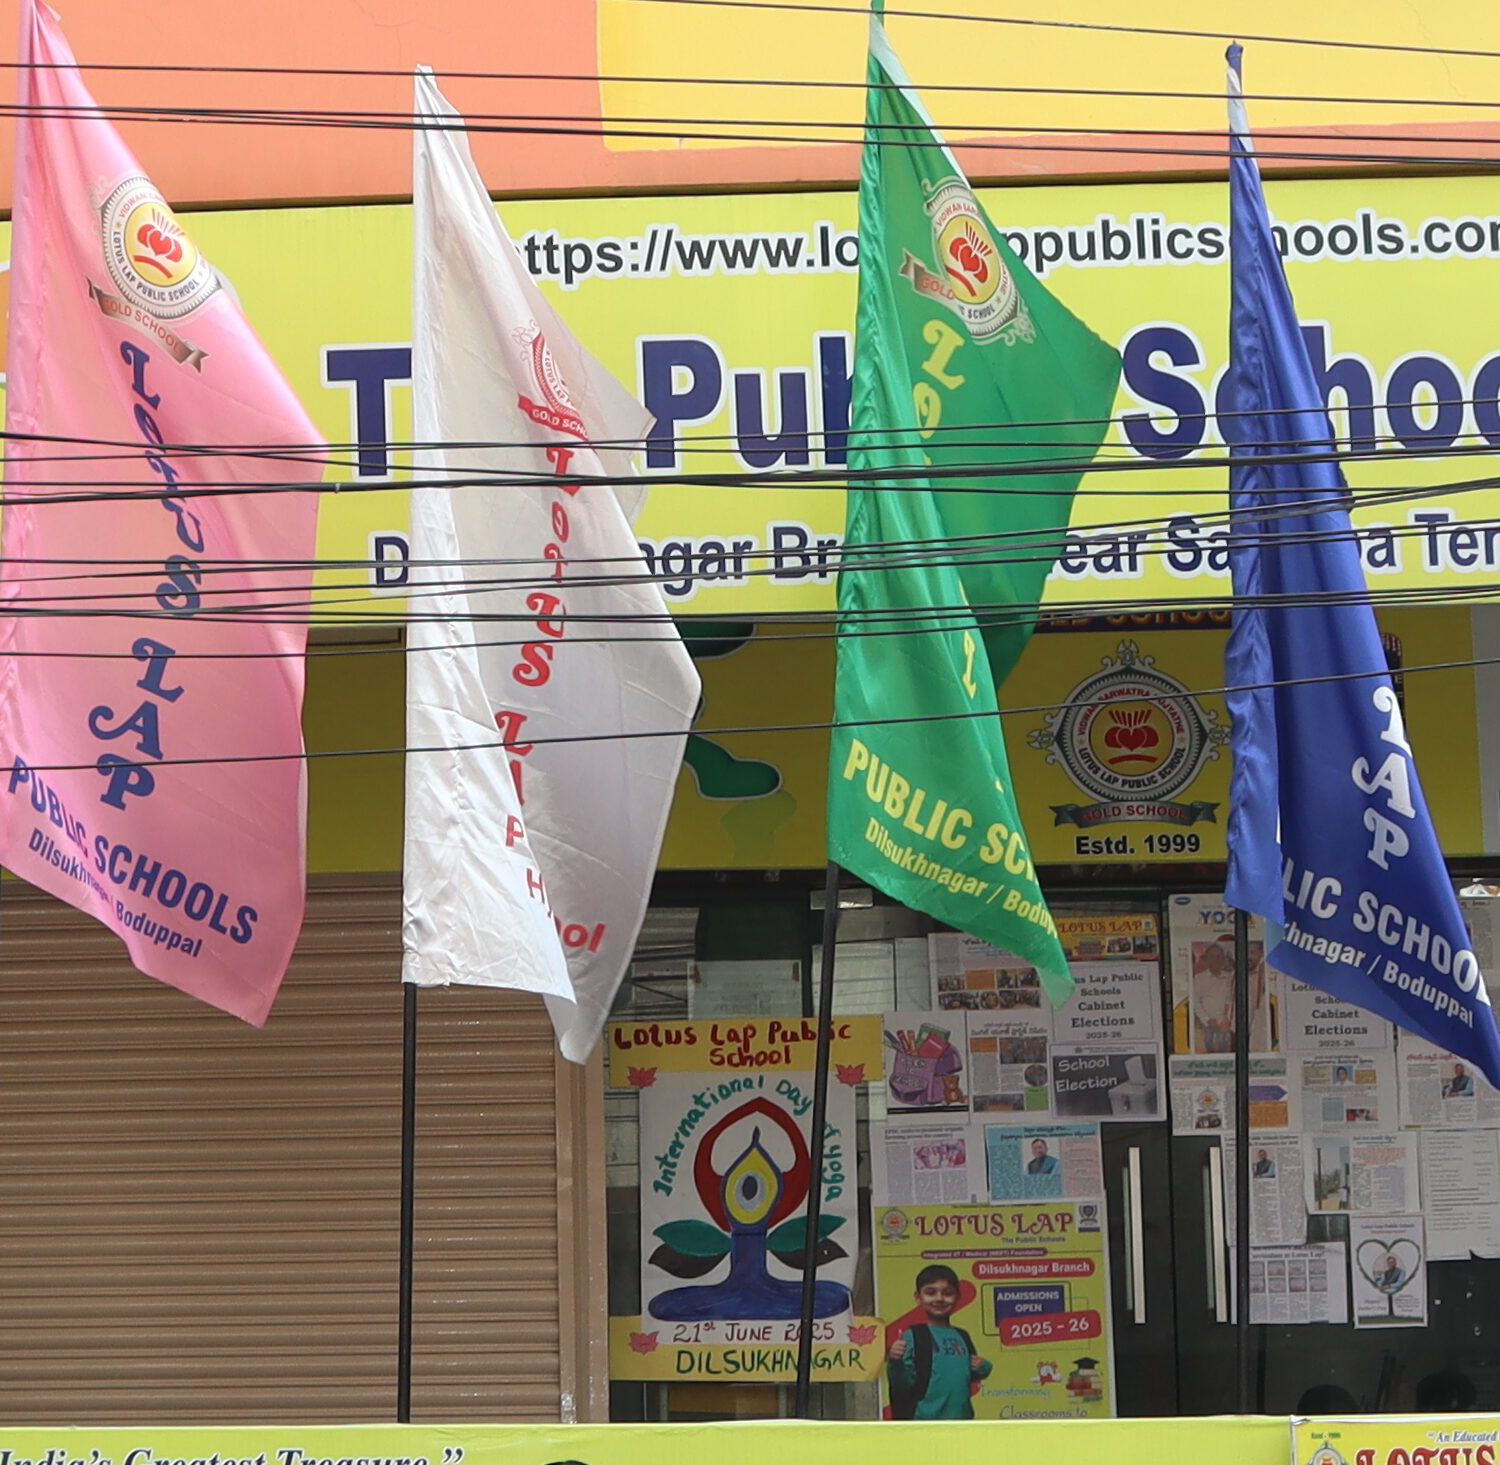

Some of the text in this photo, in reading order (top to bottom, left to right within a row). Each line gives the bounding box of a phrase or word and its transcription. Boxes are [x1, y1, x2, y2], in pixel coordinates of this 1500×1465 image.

[1060, 530, 1146, 575] ear
[88, 636, 184, 811] LAP
[843, 738, 969, 851] PUBLIC
[1127, 804, 1187, 819] SCHOOL
[1076, 833, 1200, 855] Estd. 1999
[865, 818, 990, 901] Dilsukhnagar
[94, 835, 258, 944] SCHOOLS
[115, 900, 203, 958] Boduppal
[1383, 960, 1475, 1029] Boduppal
[1079, 1001, 1126, 1011] Cabinet
[1071, 1016, 1135, 1027] Elections
[1304, 1025, 1368, 1035] Elections
[614, 1024, 756, 1053] Lotus Lap
[710, 1045, 792, 1068] School
[1058, 1057, 1110, 1072] School
[1056, 1075, 1118, 1092] Election
[652, 1076, 813, 1198] International Day
[915, 1212, 1073, 1236] LOTUS LAP
[979, 1262, 1090, 1277] Dilsukhnagar Branch
[997, 1291, 1059, 1301] ADMISSIONS
[1015, 1304, 1042, 1312] OPEN
[724, 1324, 773, 1342] JUNE
[1011, 1318, 1089, 1338] 2025 26
